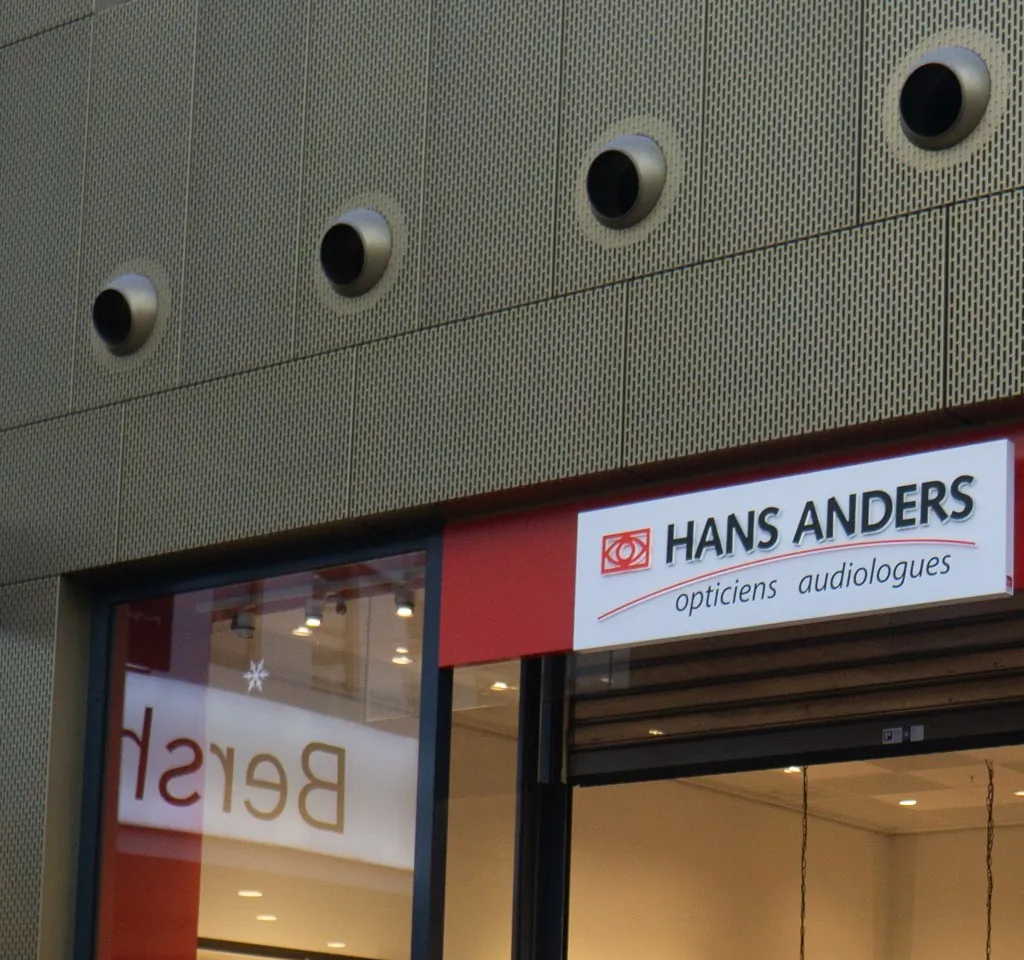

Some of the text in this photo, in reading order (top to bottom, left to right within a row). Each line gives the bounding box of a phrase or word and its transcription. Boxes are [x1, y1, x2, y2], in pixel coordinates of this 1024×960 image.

[665, 475, 976, 565] HANS ANDERS
[674, 553, 951, 617] opticiens audiologues
